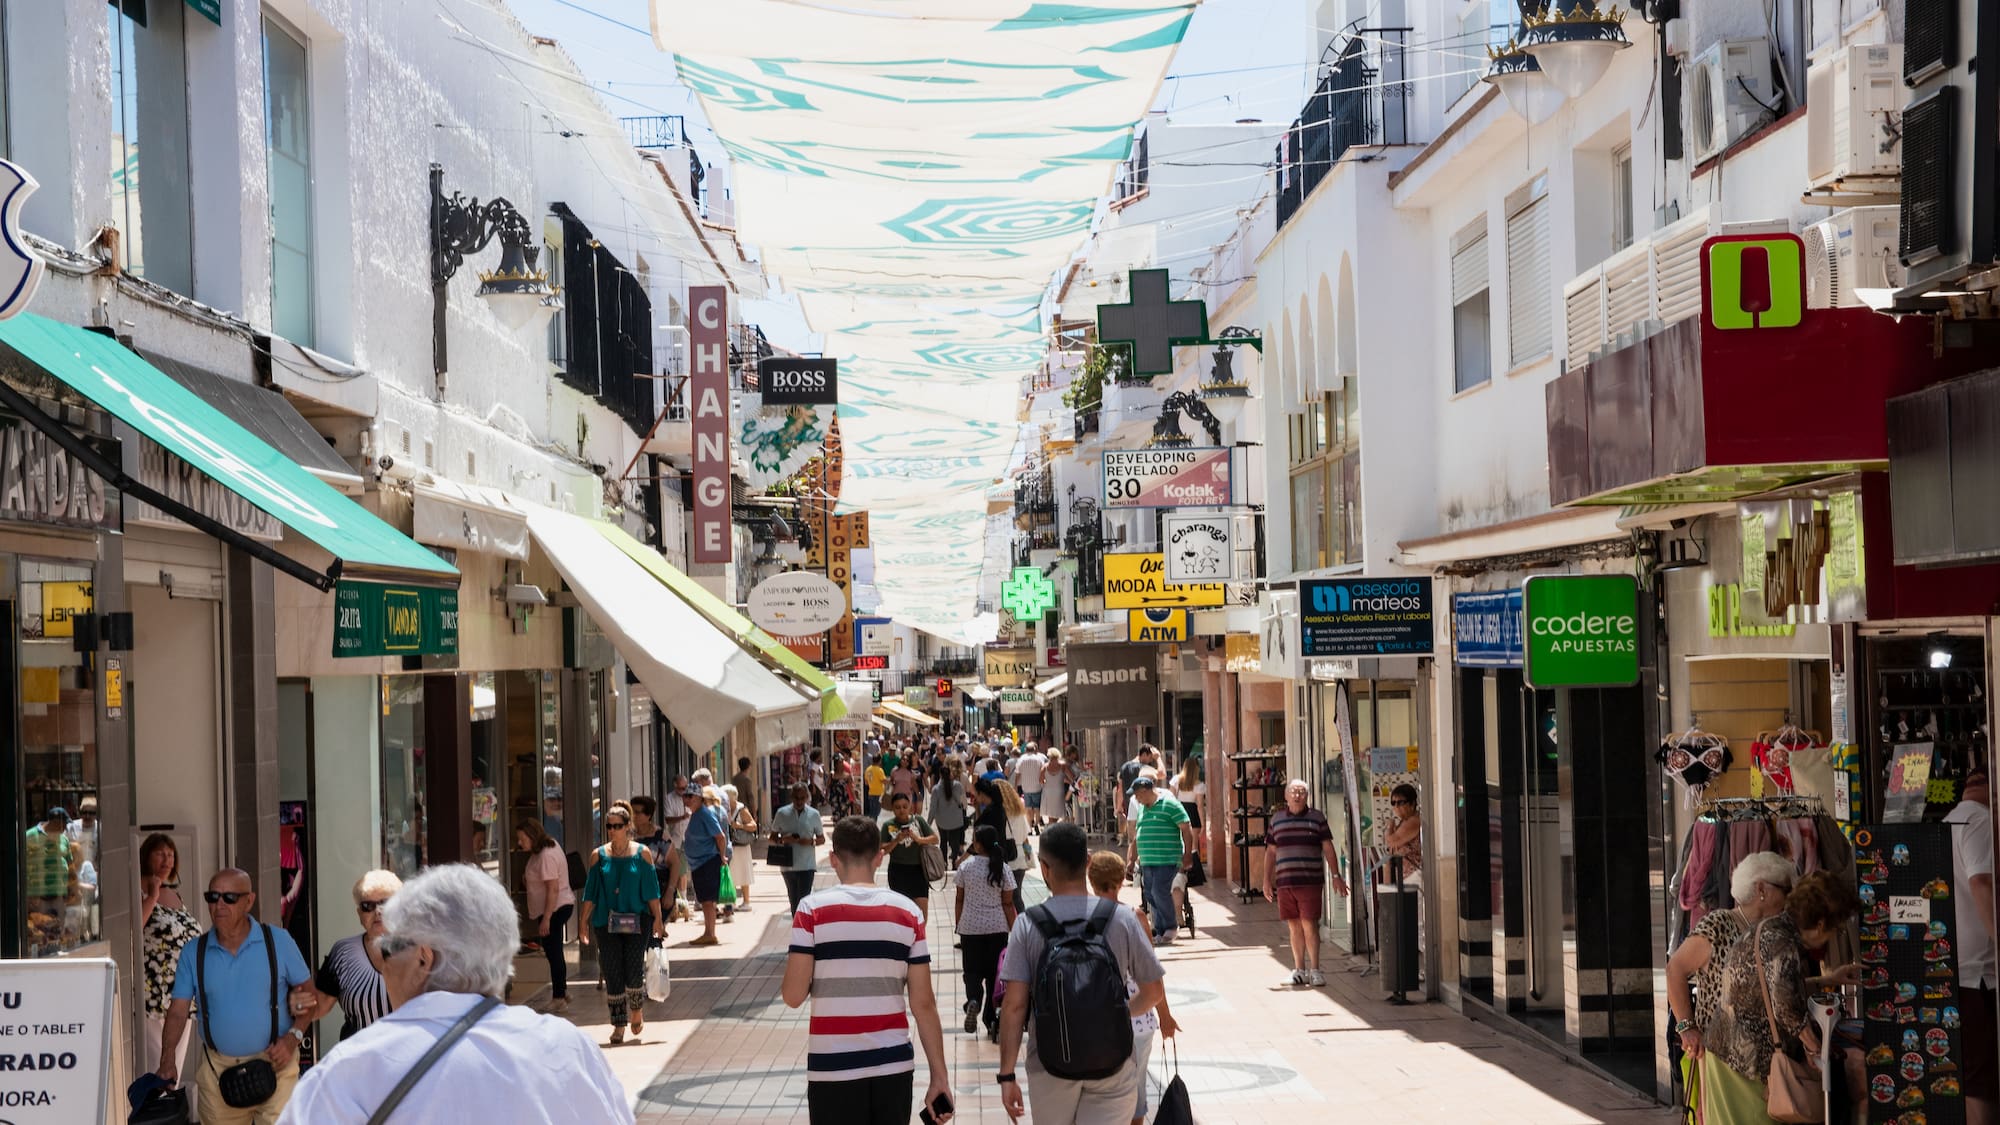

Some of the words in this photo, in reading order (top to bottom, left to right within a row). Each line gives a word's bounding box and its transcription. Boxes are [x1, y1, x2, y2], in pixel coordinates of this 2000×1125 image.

[772, 371, 826, 387] BOSS
[697, 298, 725, 551] CHANGE
[1106, 452, 1196, 464] DEVELOPING
[1107, 465, 1178, 476] REVELADO
[1108, 478, 1141, 499] 30
[1163, 484, 1213, 497] Kodak
[1178, 496, 1202, 505] FOTO
[1171, 523, 1228, 544] Charanga
[832, 519, 846, 579] TORO
[1108, 579, 1156, 593] MODA
[803, 599, 830, 608] BOSS
[1352, 595, 1421, 612] mateos
[388, 605, 418, 635] VIANDAS
[1403, 611, 1431, 621] Laboral
[1532, 611, 1634, 636] codere
[1139, 626, 1177, 641] ATM
[1551, 639, 1635, 653] APUESTAS
[987, 663, 1000, 674] LA
[1075, 666, 1148, 685] Asport
[1002, 692, 1033, 702] REGALO
[1099, 718, 1127, 726] Asport
[0, 991, 22, 1010] U
[18, 1024, 28, 1036] O
[32, 1023, 85, 1036] TABLET
